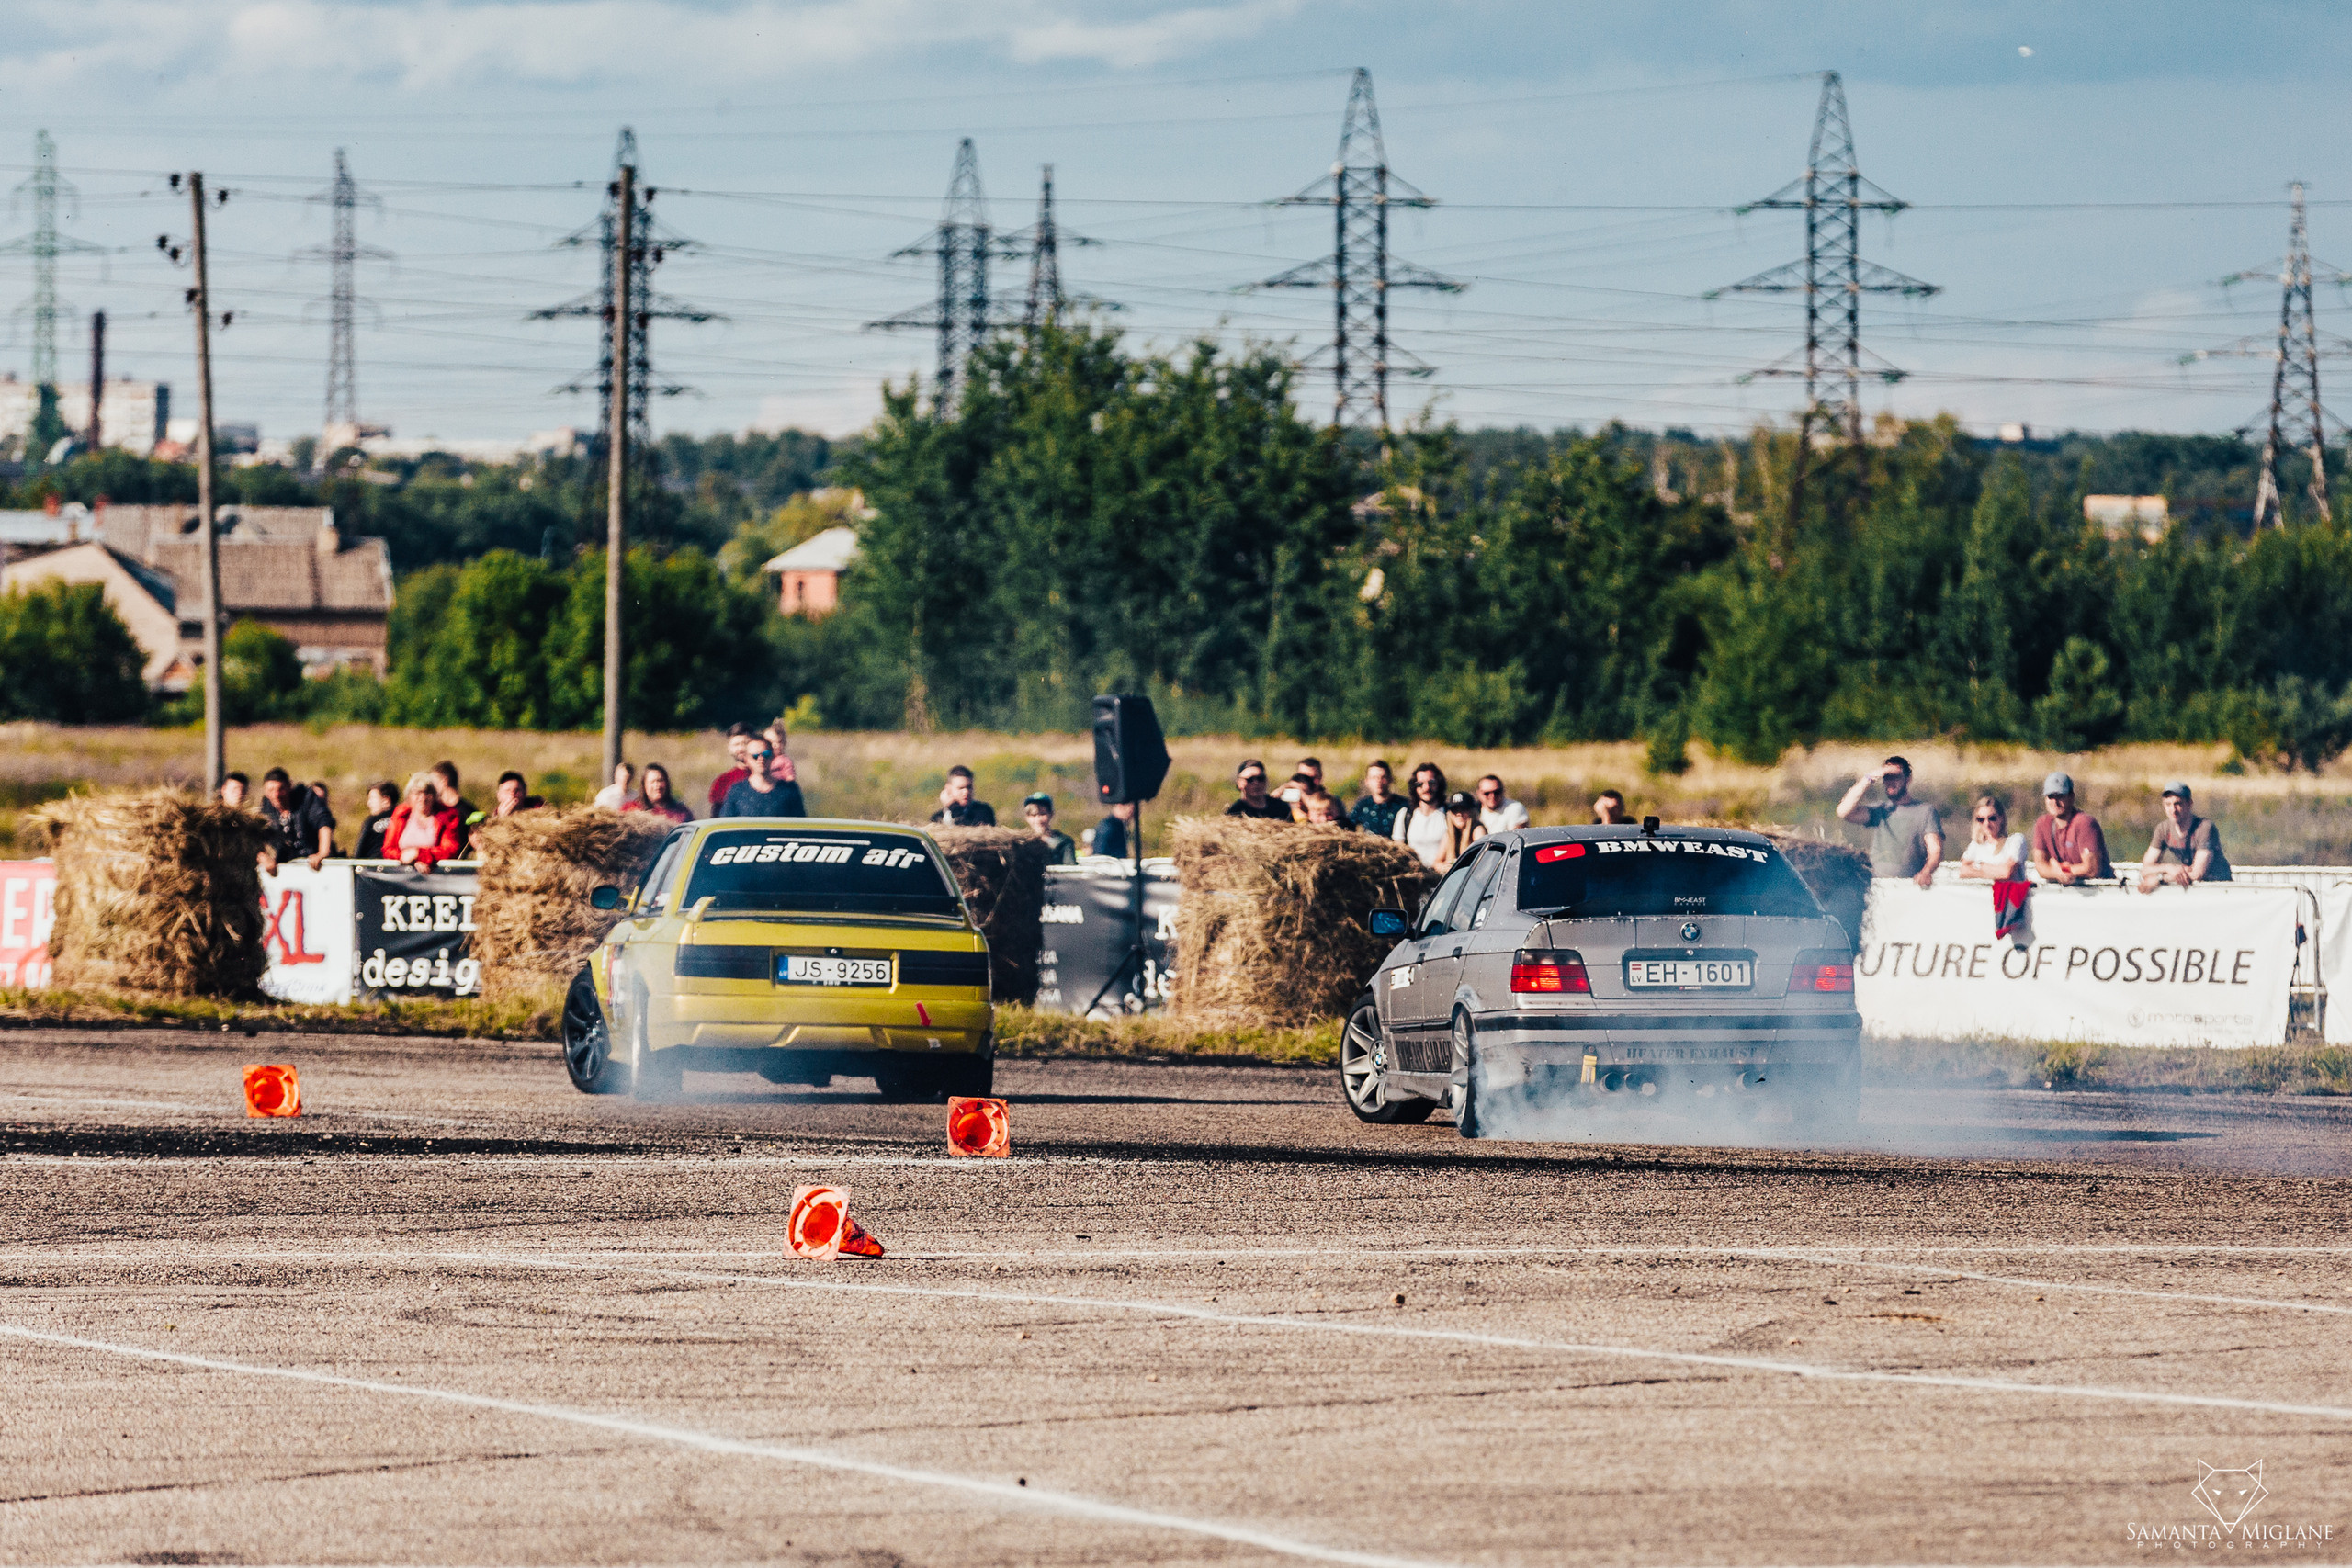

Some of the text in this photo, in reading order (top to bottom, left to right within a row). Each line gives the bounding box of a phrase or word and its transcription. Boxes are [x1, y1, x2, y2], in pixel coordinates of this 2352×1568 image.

[710, 842, 925, 869] custom afr
[1595, 840, 1769, 863] BMWEAST
[795, 961, 887, 980] JS-9256
[1646, 963, 1745, 983] EH-1601
[2001, 945, 2057, 980] OF
[2066, 947, 2255, 987] POSSIBLE
